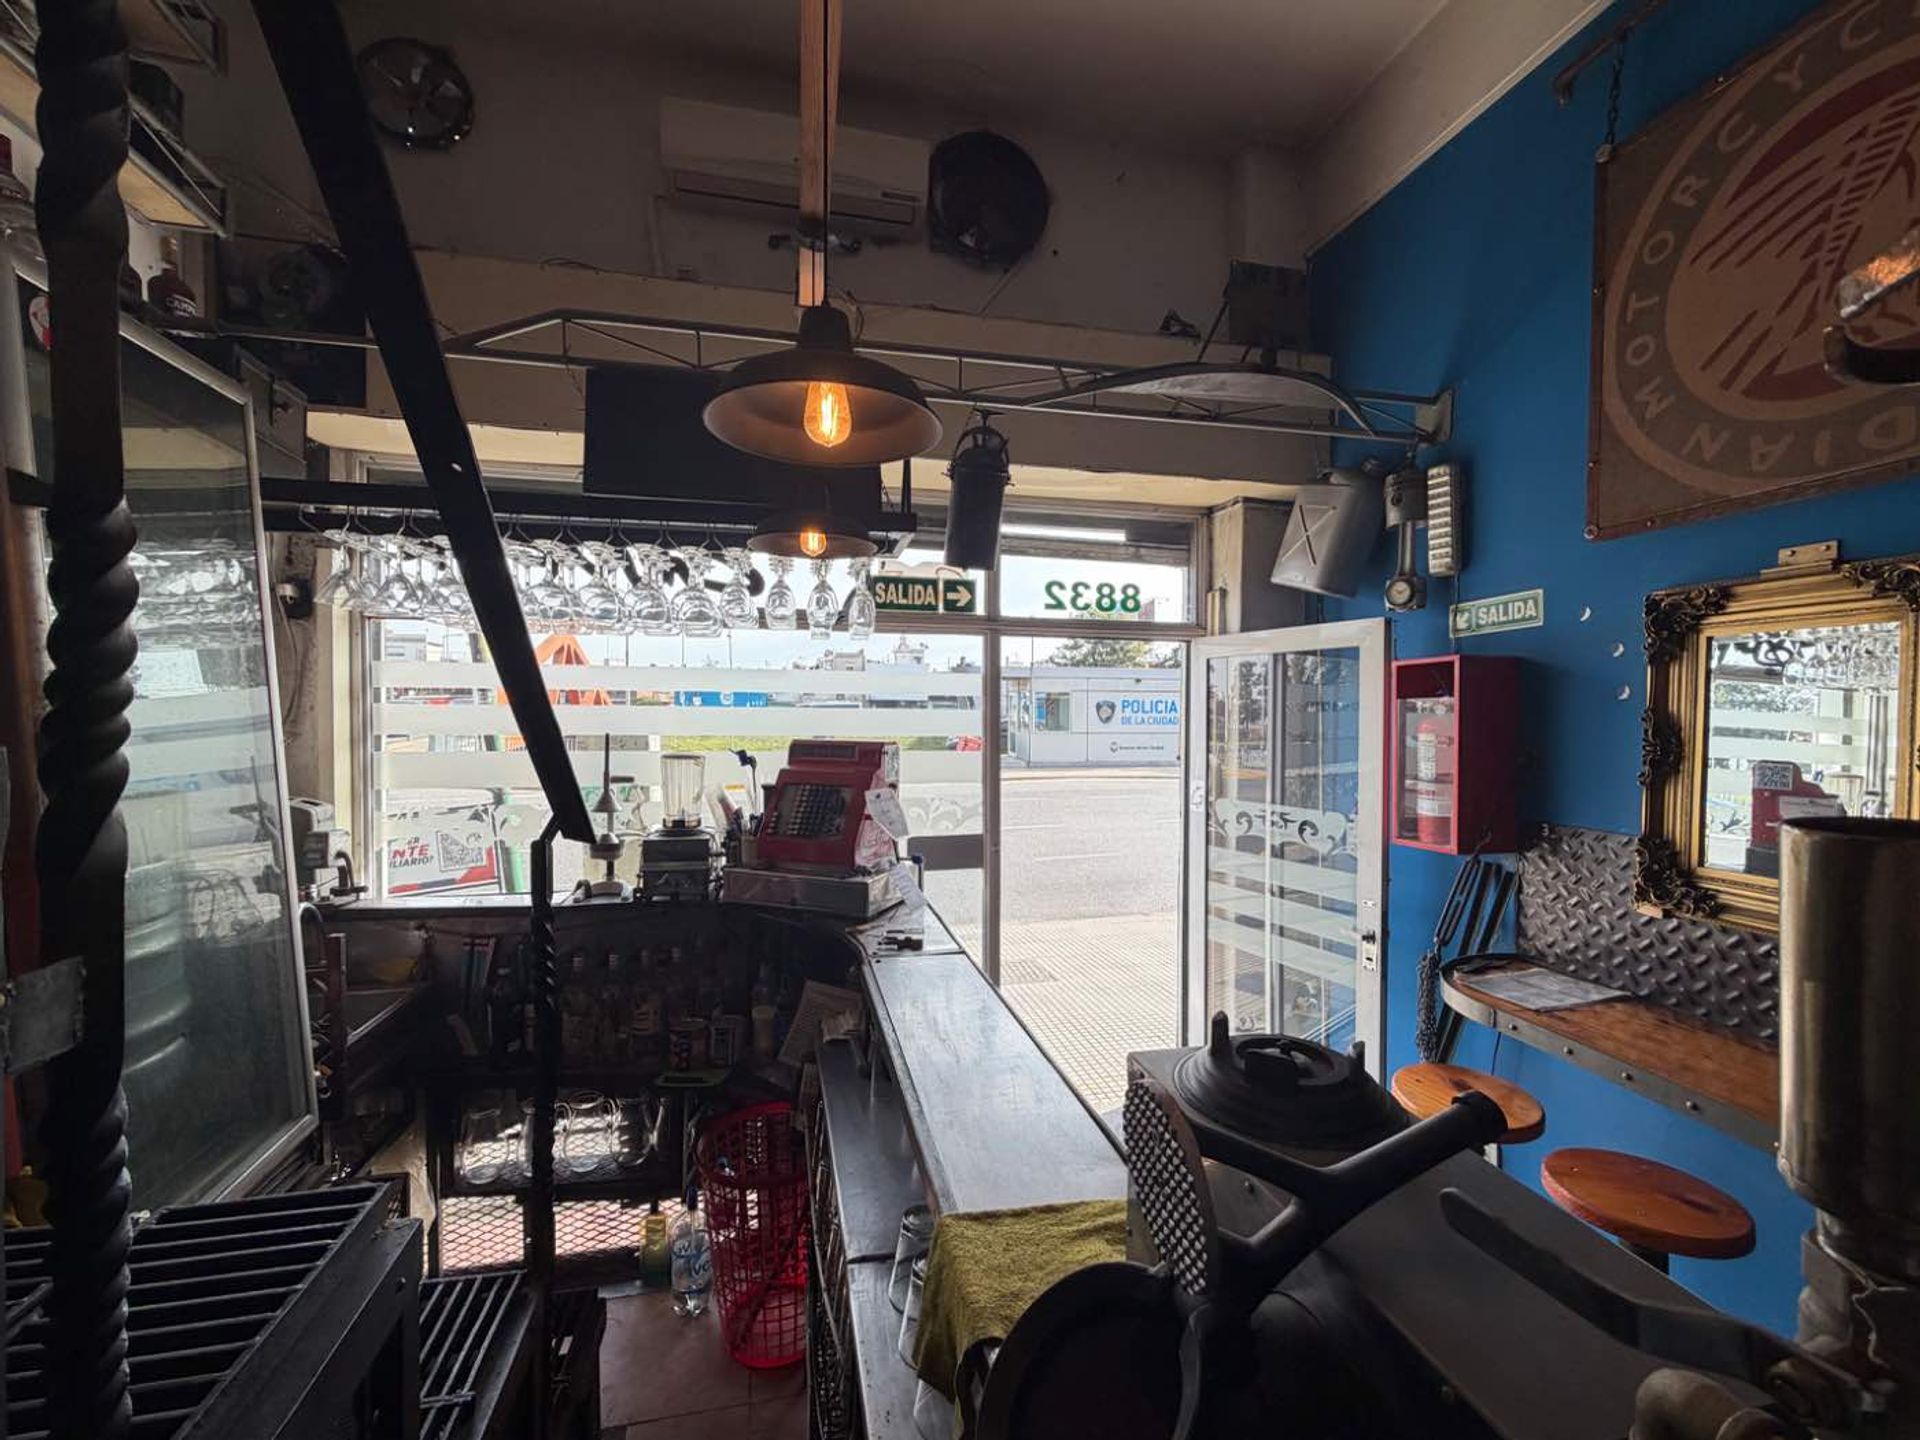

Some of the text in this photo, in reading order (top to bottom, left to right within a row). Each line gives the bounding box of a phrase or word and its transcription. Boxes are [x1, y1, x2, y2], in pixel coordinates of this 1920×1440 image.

[1625, 0, 1920, 424] MOTORCYC
[875, 582, 936, 606] SALIDA
[1478, 599, 1537, 625] SALIDA
[1121, 699, 1178, 714] POLICIA
[1121, 716, 1180, 726] DE LA CIUDAD
